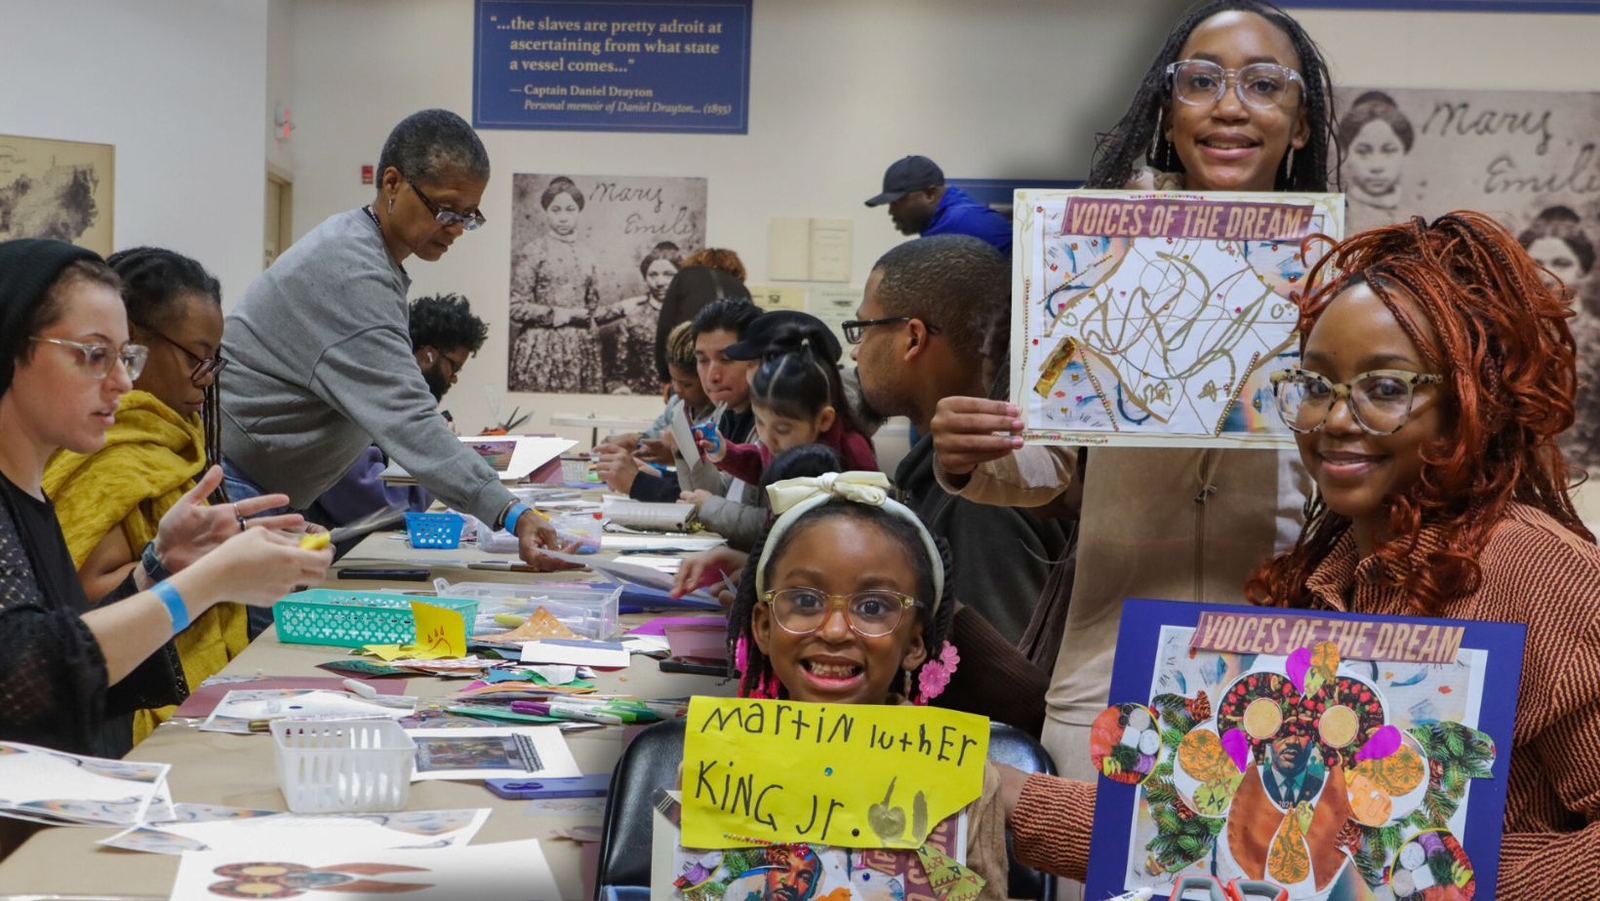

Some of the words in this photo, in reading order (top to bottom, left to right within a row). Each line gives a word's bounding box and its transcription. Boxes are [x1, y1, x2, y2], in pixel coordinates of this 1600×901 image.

[538, 16, 581, 31] slaves
[584, 21, 607, 32] are
[611, 22, 656, 37] pretty
[658, 20, 705, 33] adroit
[708, 22, 722, 33] at
[510, 38, 601, 55] ascertaining
[604, 39, 641, 52] from
[643, 40, 680, 53] what
[684, 42, 719, 54] state
[509, 60, 518, 70] a
[521, 58, 564, 71] vessel
[524, 84, 568, 98] Captain
[570, 85, 606, 97] Daniel
[609, 87, 653, 101] Drayton
[524, 99, 565, 111] Personal
[567, 102, 604, 112] memoir
[607, 101, 617, 114] of
[617, 103, 650, 113] Daniel
[703, 104, 732, 116] (1855)
[1421, 100, 1553, 156] Mary
[1483, 141, 1600, 195] Emil
[588, 181, 664, 213] Mary
[624, 205, 697, 241] Emily
[1071, 202, 1146, 235] VOICES
[1151, 204, 1180, 237] OF
[1182, 205, 1223, 238] THE
[1225, 206, 1303, 240] DREAM
[1205, 615, 1285, 652] VOICES
[1288, 617, 1322, 653] OF
[1326, 621, 1374, 658] THE
[1374, 624, 1465, 663] DREAM
